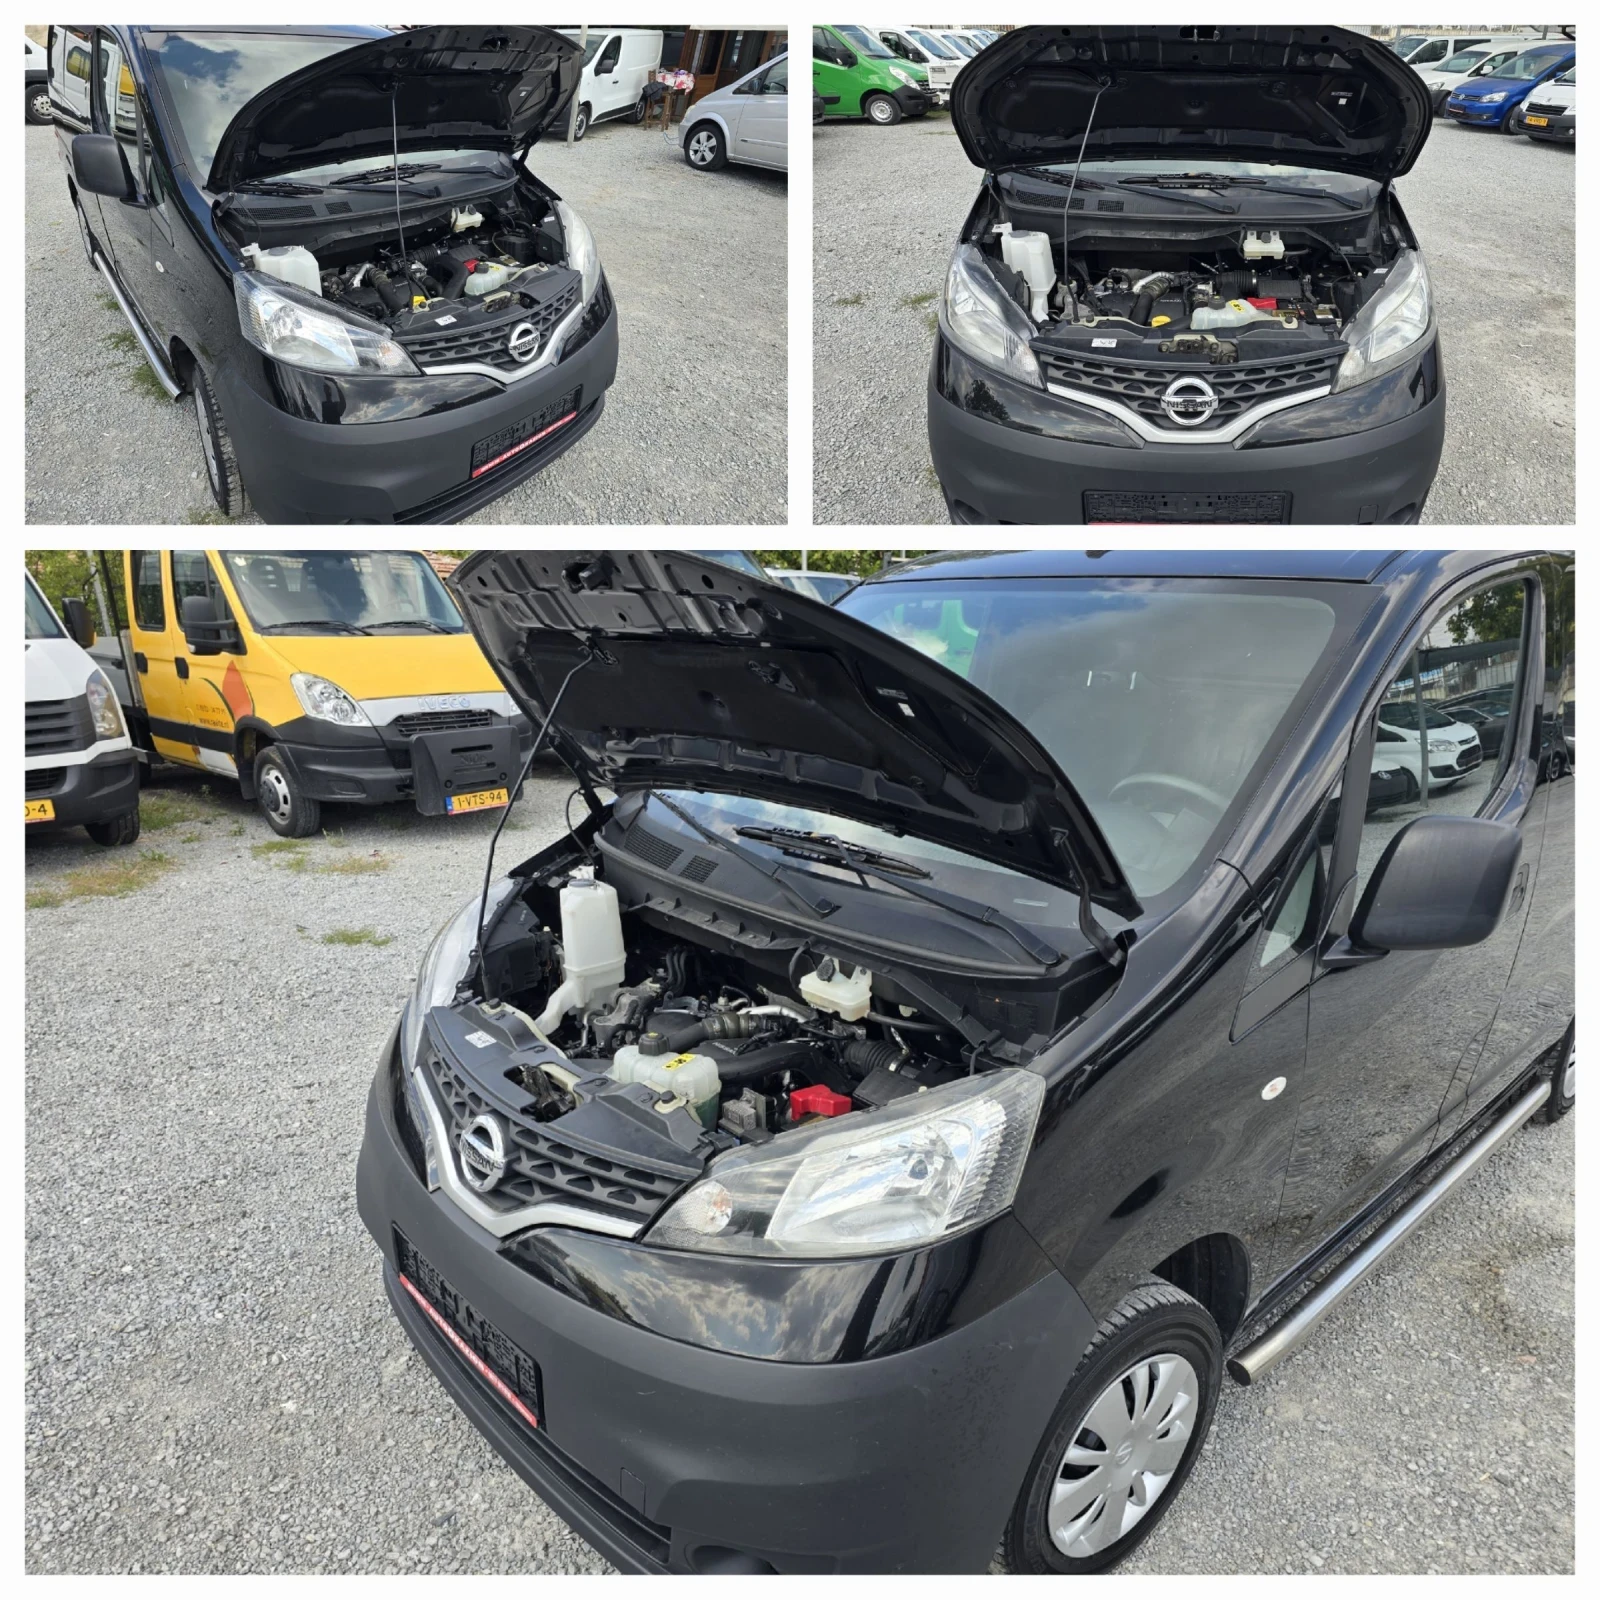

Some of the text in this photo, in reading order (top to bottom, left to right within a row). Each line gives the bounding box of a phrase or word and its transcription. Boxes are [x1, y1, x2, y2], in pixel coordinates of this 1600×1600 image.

[513, 334, 539, 351] NISSAN
[1166, 399, 1213, 409] NISSAN
[417, 696, 471, 710] IVECO
[457, 791, 503, 808] 1-VTS-94
[461, 1140, 495, 1173] NISSAN
